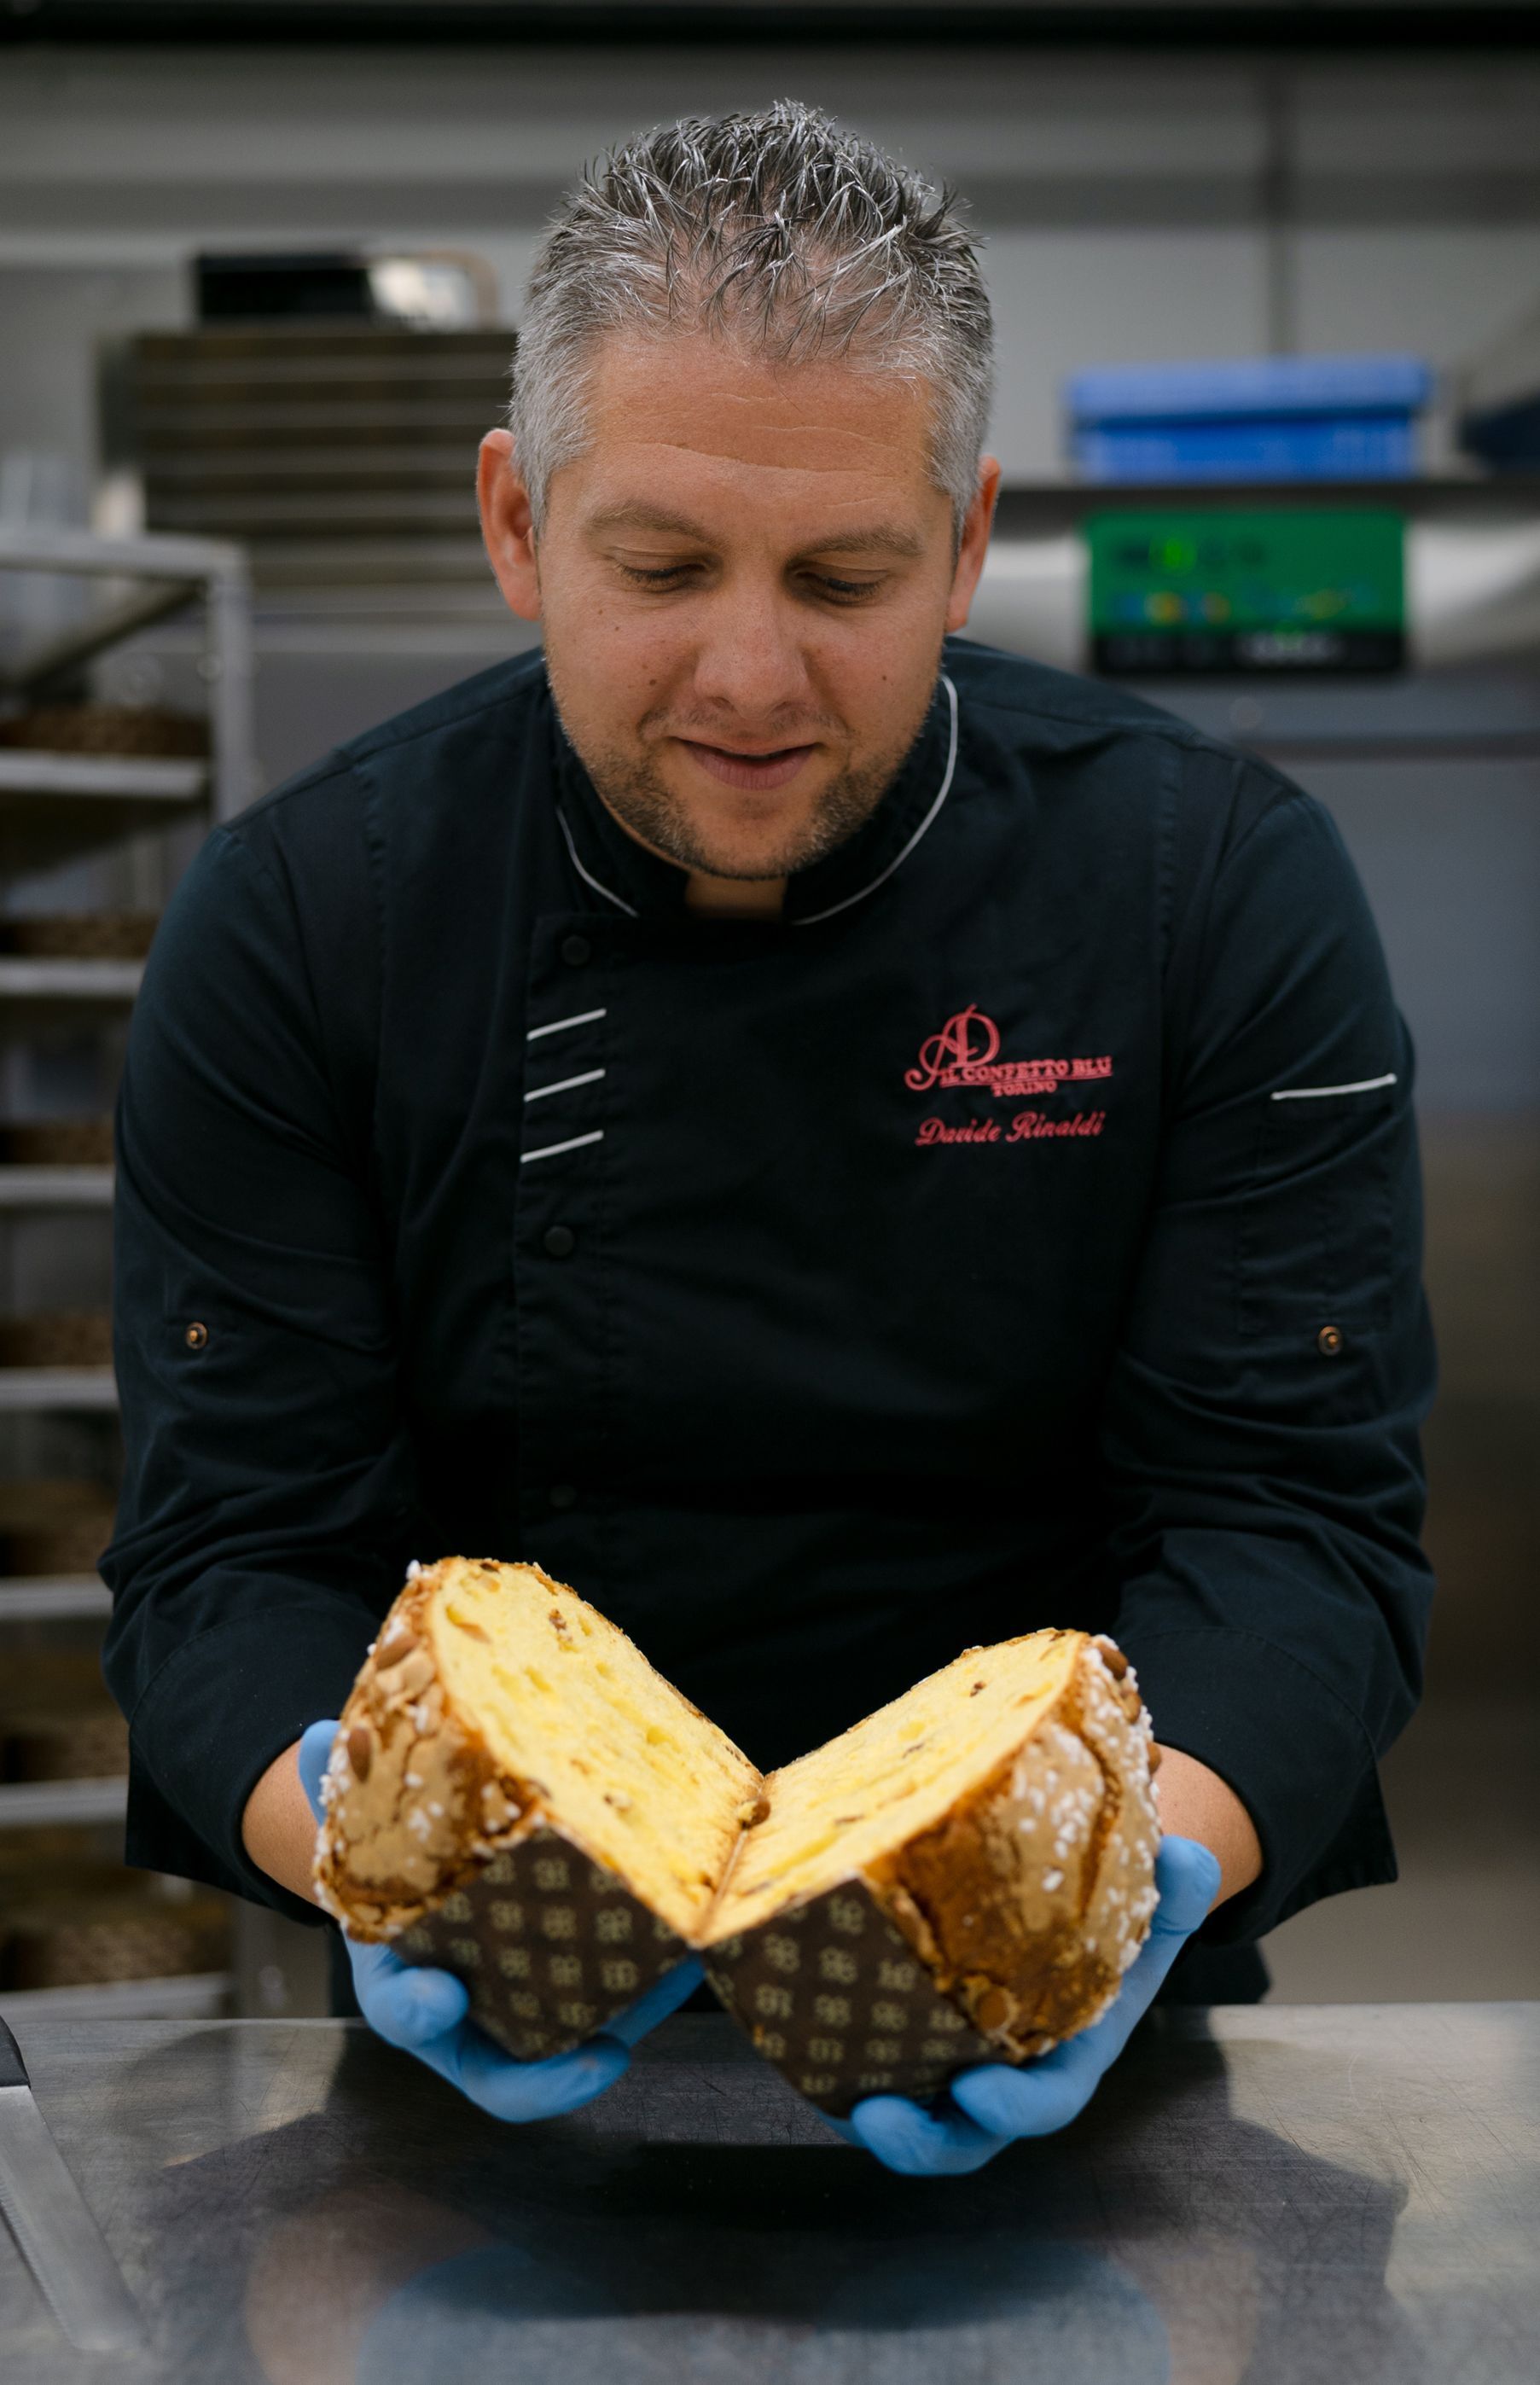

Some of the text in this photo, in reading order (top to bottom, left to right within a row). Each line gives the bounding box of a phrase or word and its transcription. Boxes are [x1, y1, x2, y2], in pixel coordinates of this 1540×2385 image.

[991, 1079, 1058, 1097] TORINO
[915, 1111, 1107, 1146] Davide Rinaldi
